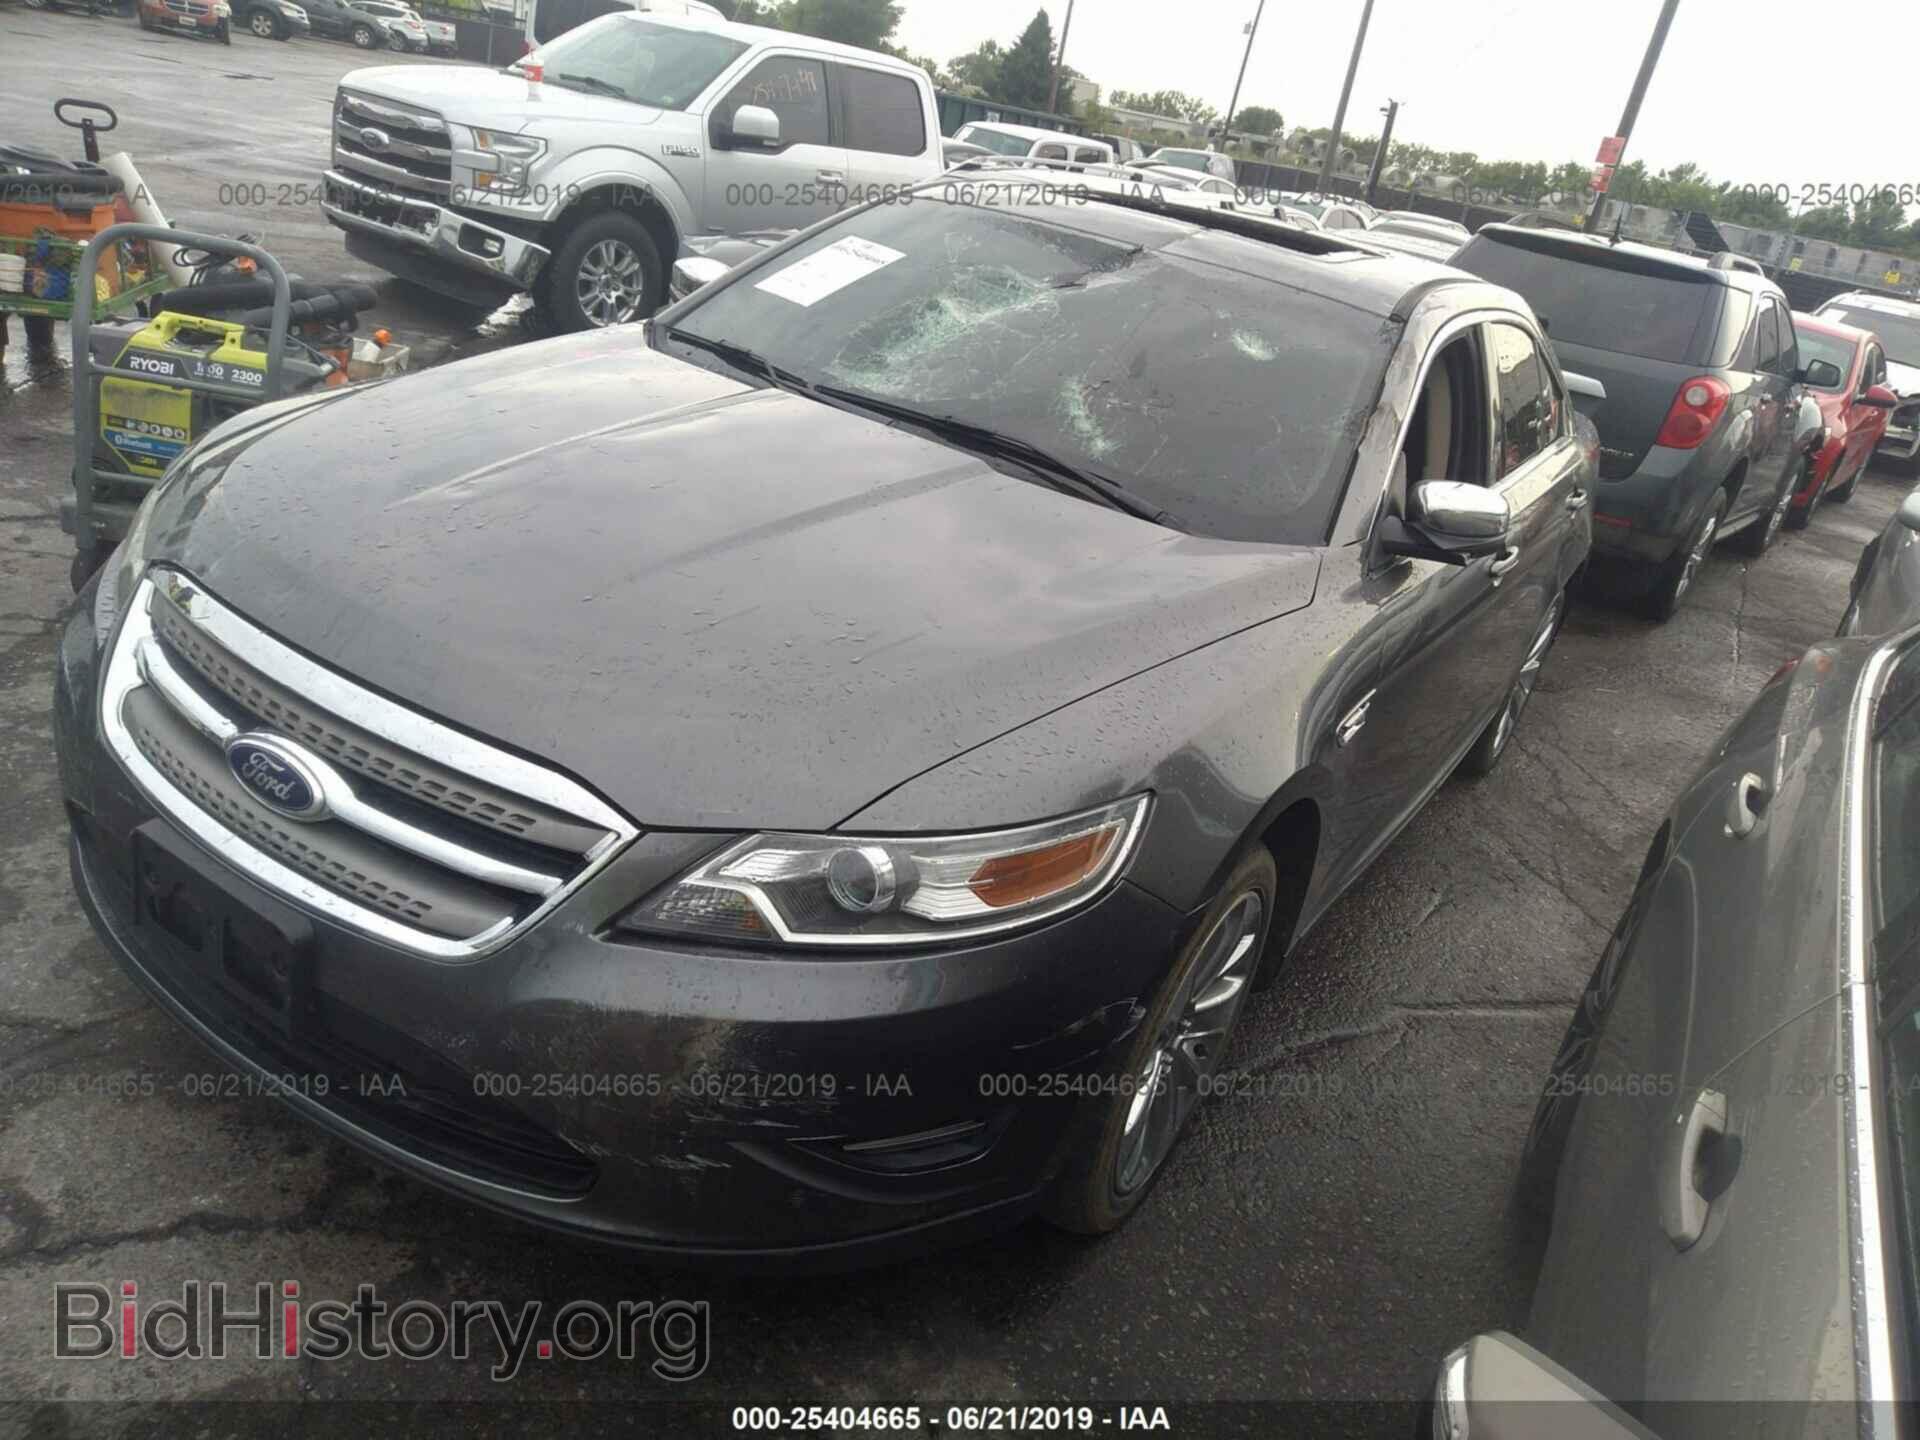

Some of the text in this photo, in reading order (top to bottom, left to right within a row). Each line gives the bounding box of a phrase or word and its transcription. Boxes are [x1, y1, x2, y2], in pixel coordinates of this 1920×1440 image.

[130, 356, 174, 375] RYOBI
[231, 368, 263, 383] 2300
[242, 752, 296, 800] Ford
